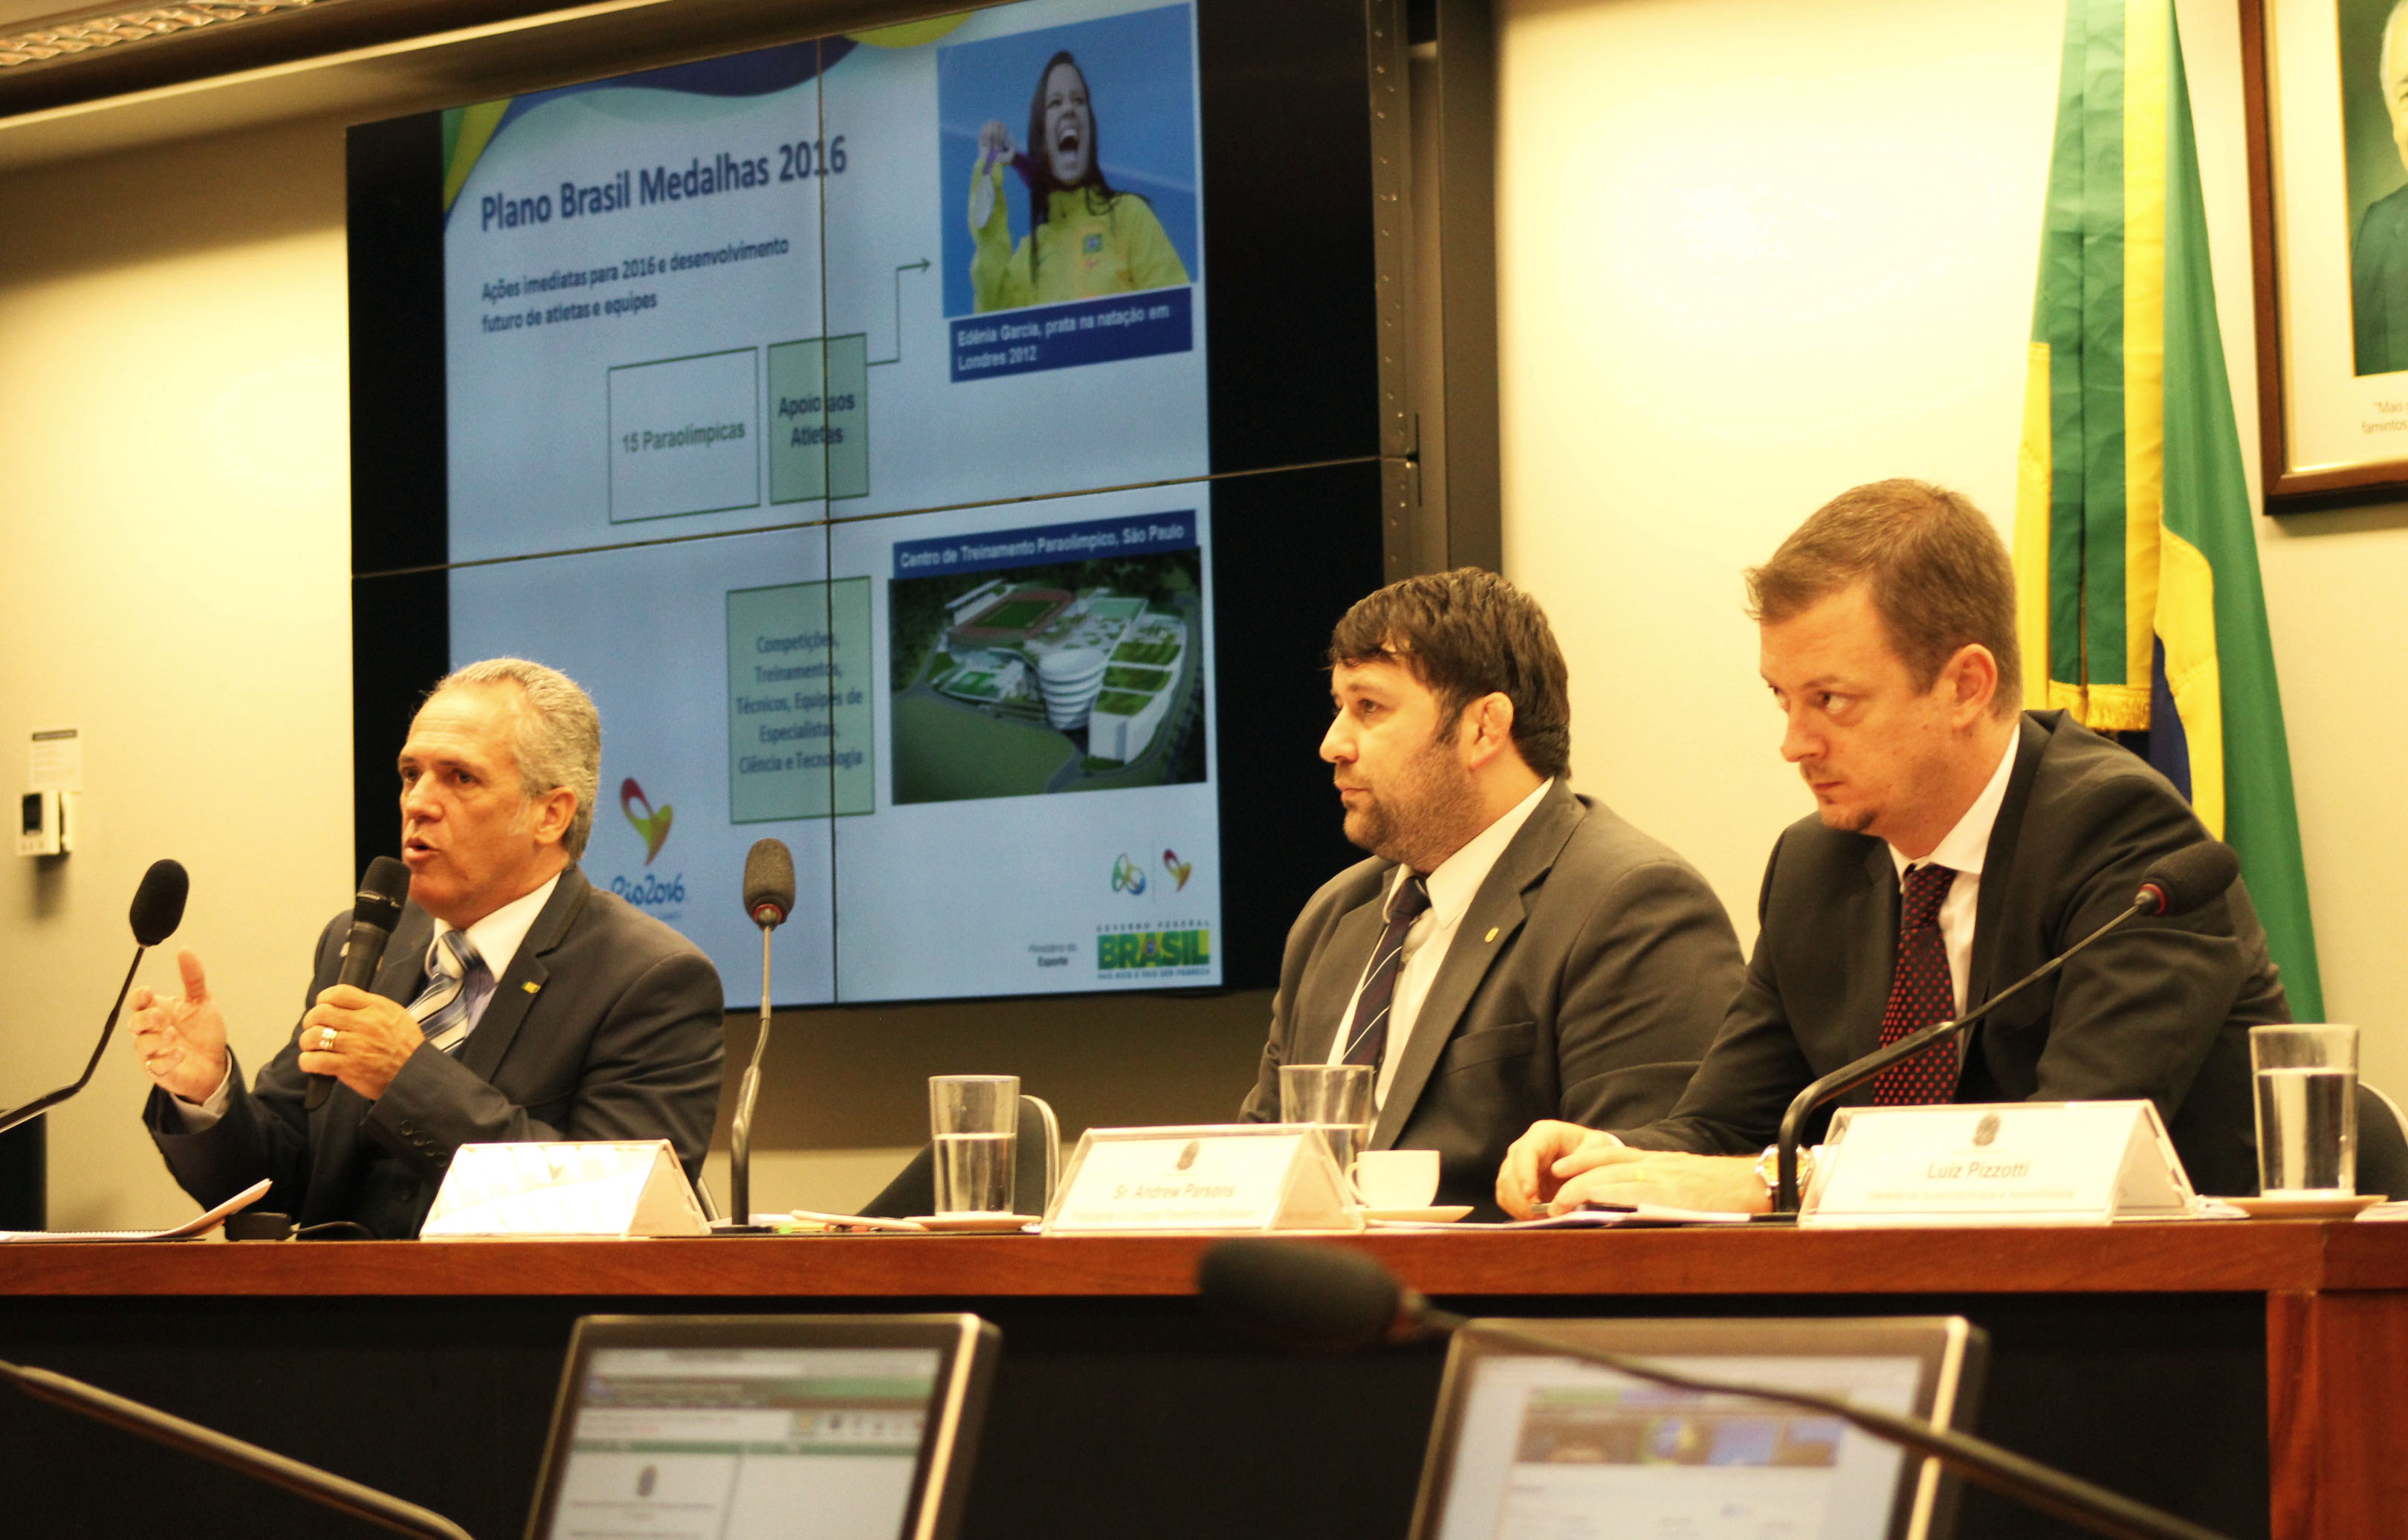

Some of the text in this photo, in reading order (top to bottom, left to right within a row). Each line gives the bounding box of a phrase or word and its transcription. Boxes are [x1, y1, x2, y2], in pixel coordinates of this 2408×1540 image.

[482, 135, 846, 231] Plano Brasil Medalhas 2016
[482, 237, 789, 304] Ações imediatas para 2016 e desenvolvimento
[482, 289, 657, 333] futuro de atletas e equipes
[1046, 317, 1076, 338] prata
[1079, 315, 1094, 329] na
[1097, 307, 1145, 327] natação
[1149, 305, 1169, 320] em
[958, 345, 1037, 371] Londres 2012
[779, 394, 855, 421] Apoio aos
[623, 433, 638, 453] 15
[901, 551, 940, 567] Centro
[942, 549, 957, 563] de
[960, 540, 1035, 561] Treinamento
[1122, 528, 1146, 544] São
[1148, 523, 1184, 541] Paulo
[796, 748, 862, 770] Tecnoogia
[1098, 930, 1210, 969] BRASIL
[1926, 1160, 2030, 1179] Luiz Pizzotti
